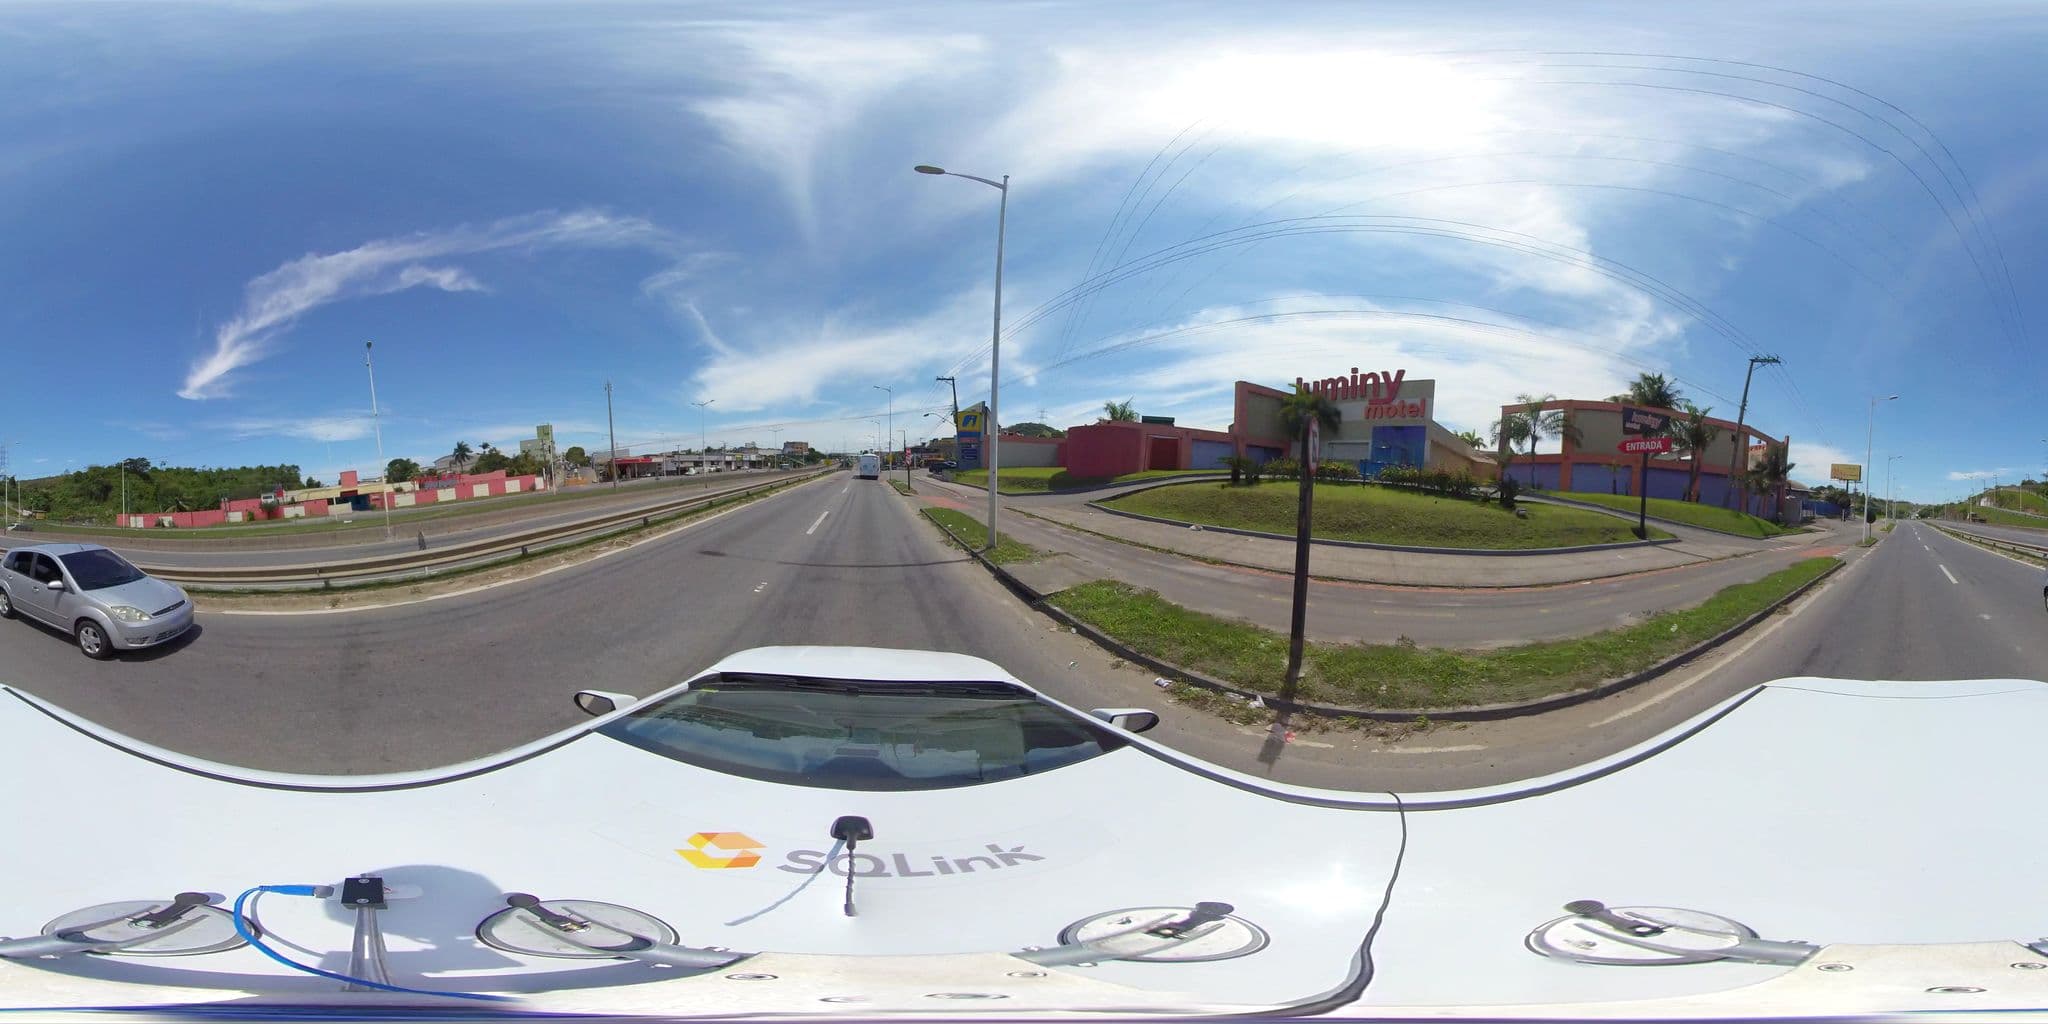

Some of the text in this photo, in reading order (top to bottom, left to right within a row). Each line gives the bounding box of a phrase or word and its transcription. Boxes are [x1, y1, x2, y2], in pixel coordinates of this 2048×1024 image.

[1364, 398, 1426, 419] motel
[1625, 440, 1663, 451] ENTRADA
[776, 843, 1046, 877] SQLink
